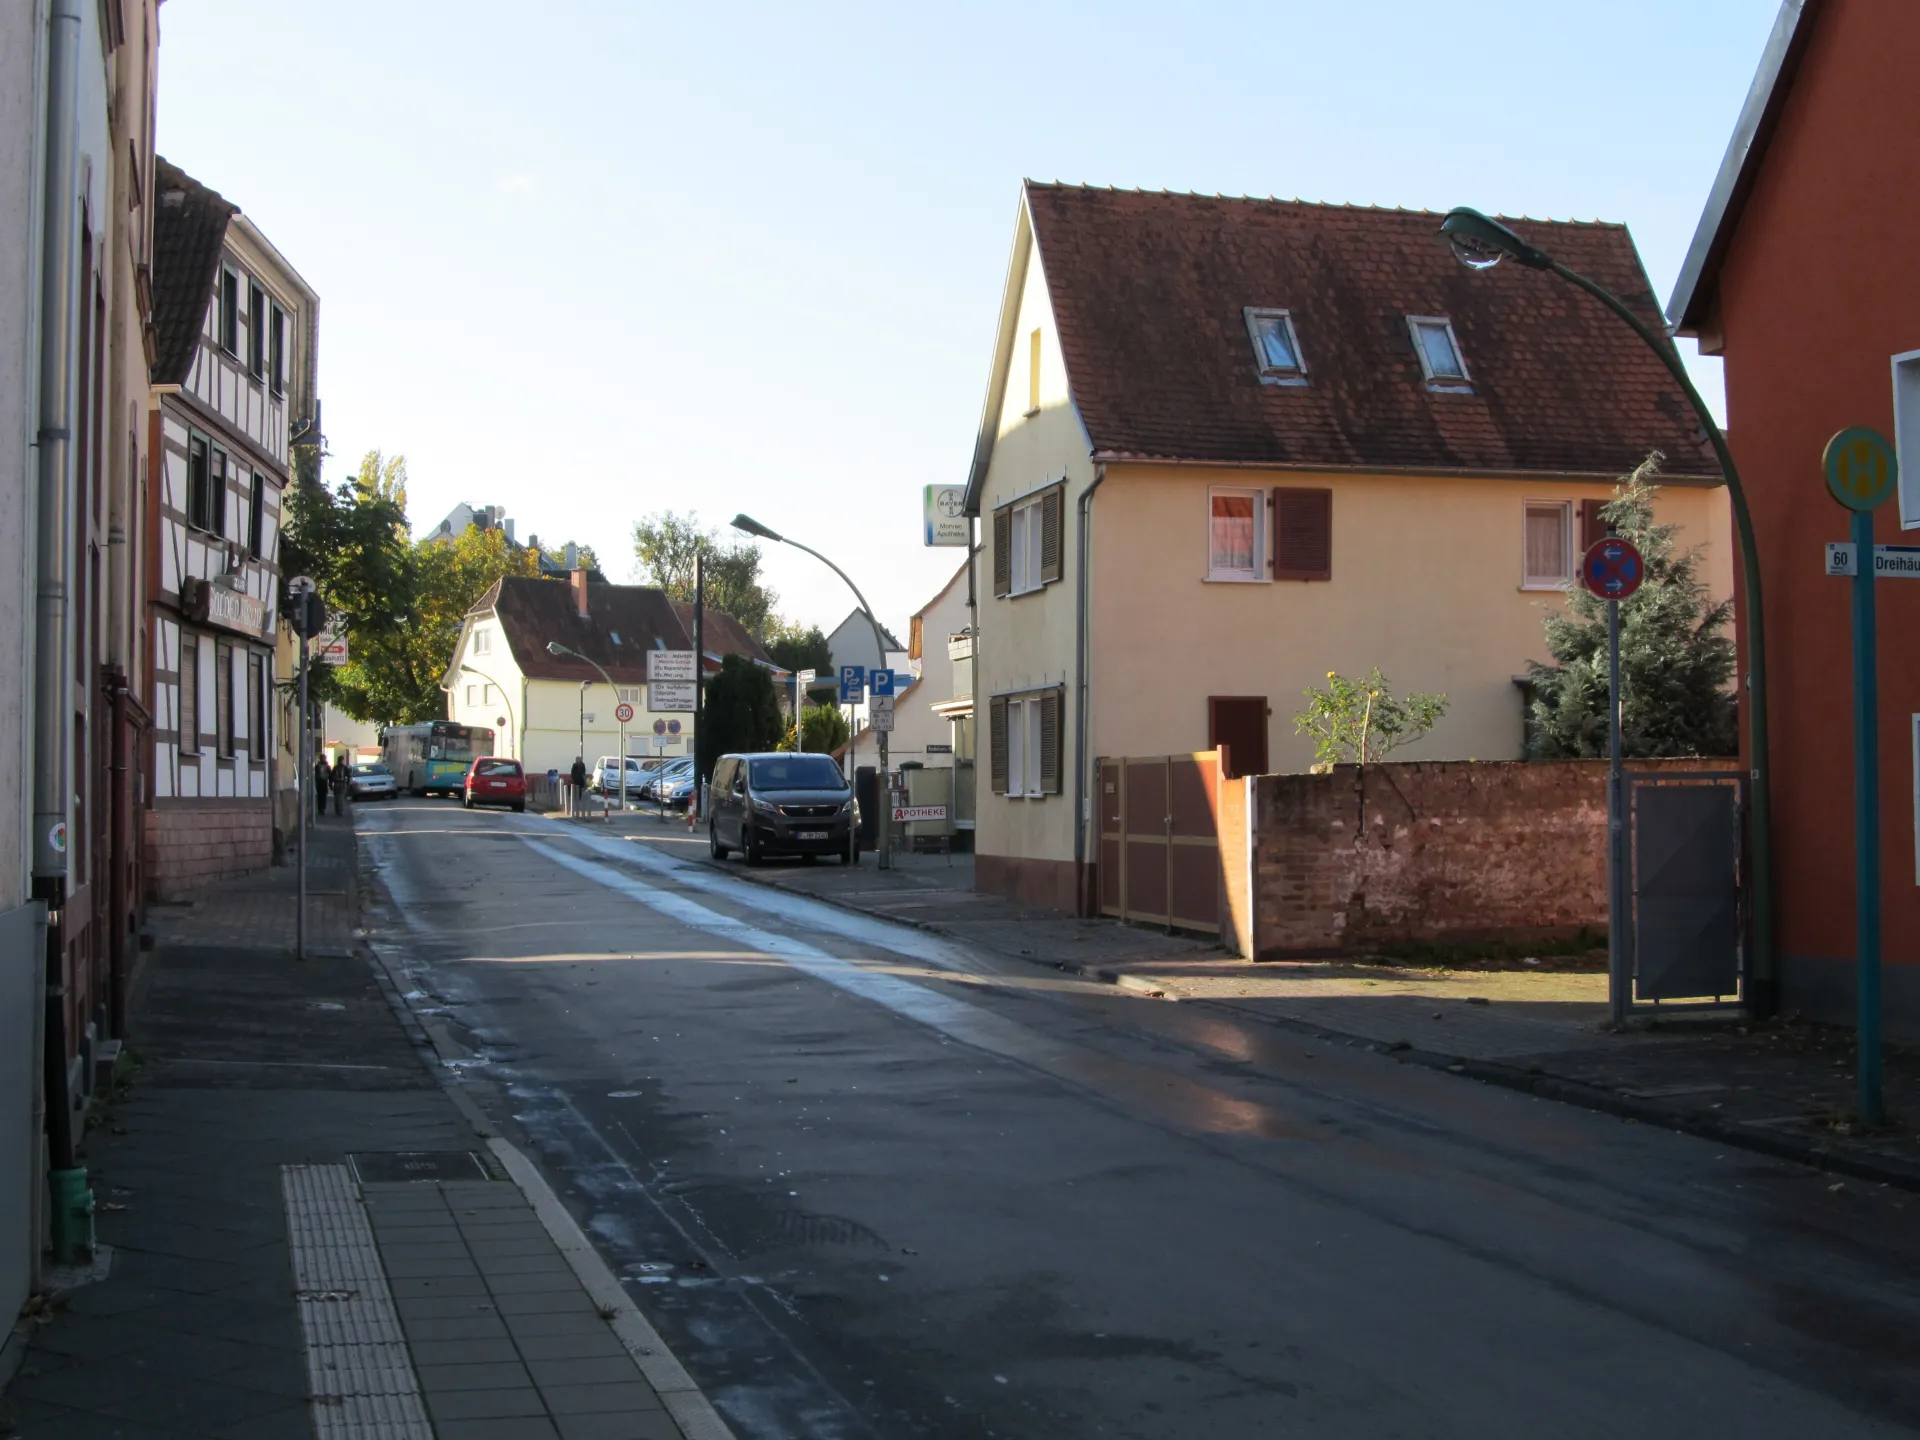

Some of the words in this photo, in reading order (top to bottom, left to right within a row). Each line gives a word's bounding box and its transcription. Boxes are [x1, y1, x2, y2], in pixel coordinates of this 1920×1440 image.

[1849, 445, 1876, 492] H
[1833, 551, 1848, 566] 60
[1875, 555, 1920, 572] Dreihäu
[844, 668, 855, 684] P
[875, 672, 889, 693] P
[619, 708, 630, 718] 30
[894, 808, 945, 820] APOTHEKE
